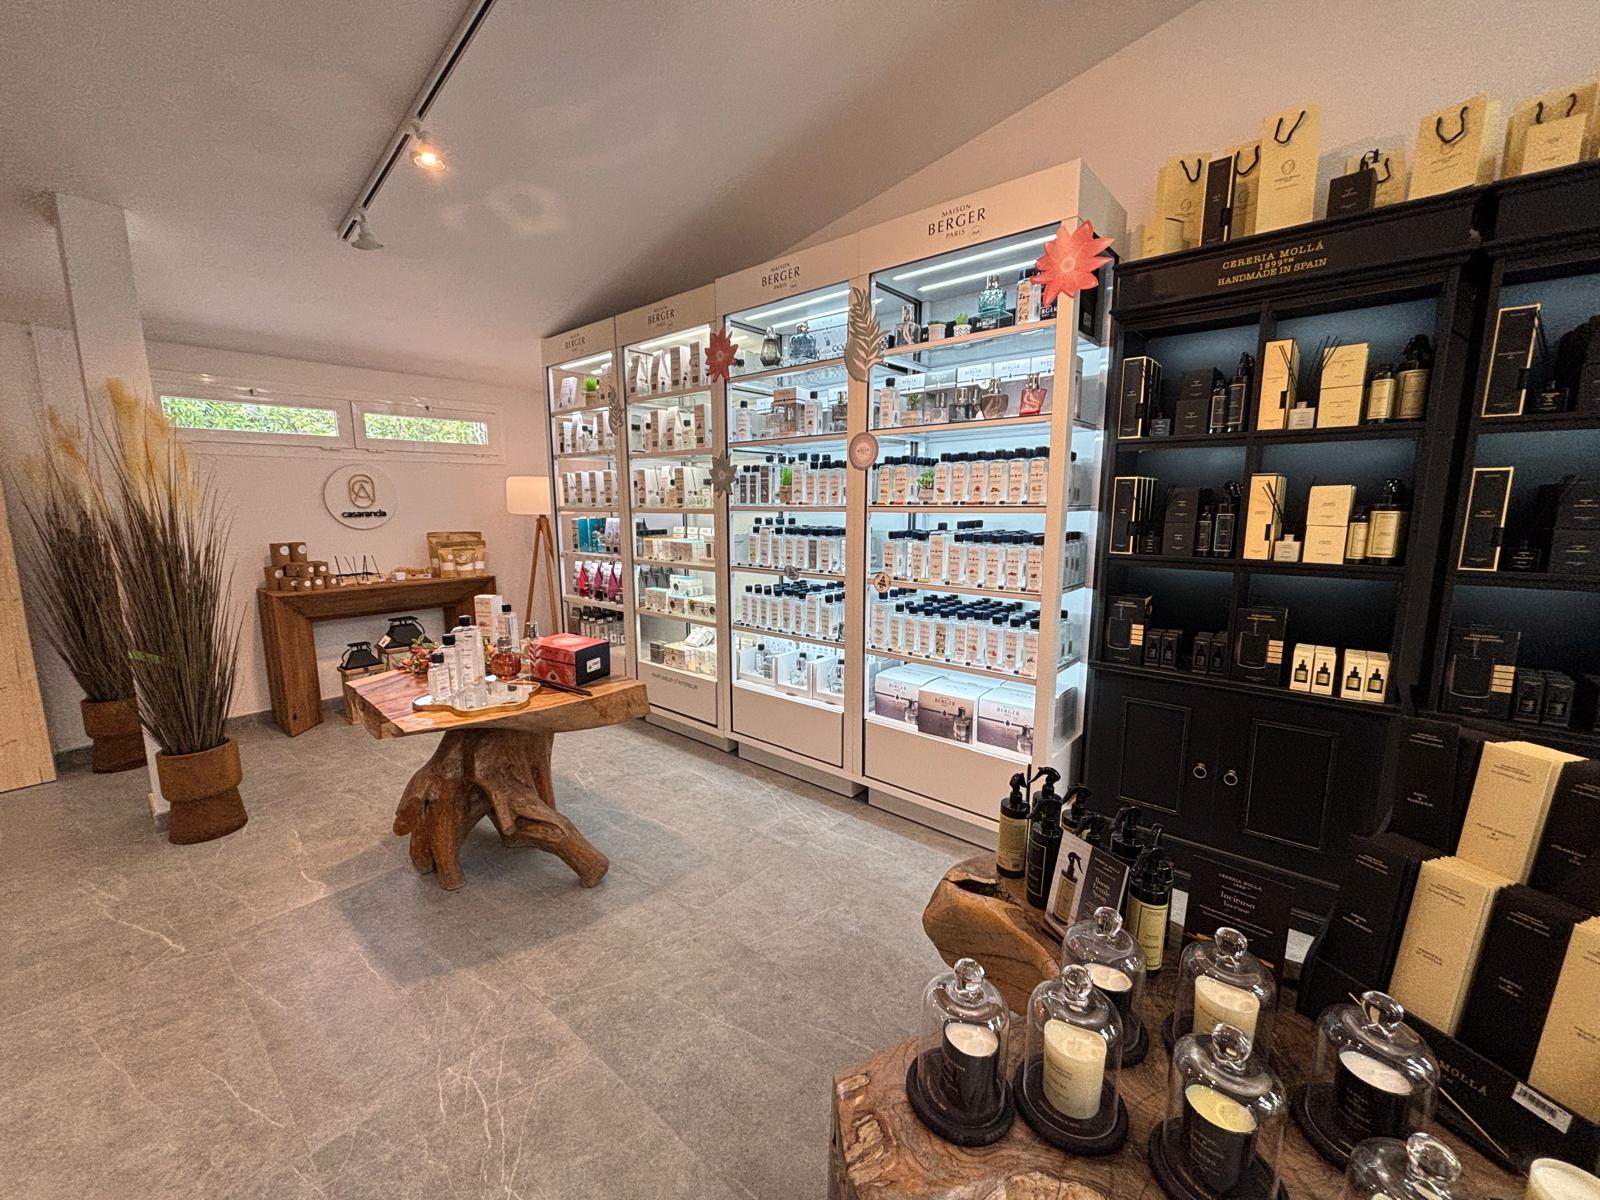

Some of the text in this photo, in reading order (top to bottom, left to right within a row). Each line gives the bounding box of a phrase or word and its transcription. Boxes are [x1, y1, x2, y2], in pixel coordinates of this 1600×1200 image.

[941, 203, 971, 217] MAISON
[928, 208, 986, 236] BERGER
[945, 229, 966, 239] PARIS
[1222, 252, 1275, 270] CERERIA
[761, 266, 800, 287] BERGER
[1217, 258, 1328, 286] HANDMADE IN SPAIN
[647, 309, 675, 325] BERGER
